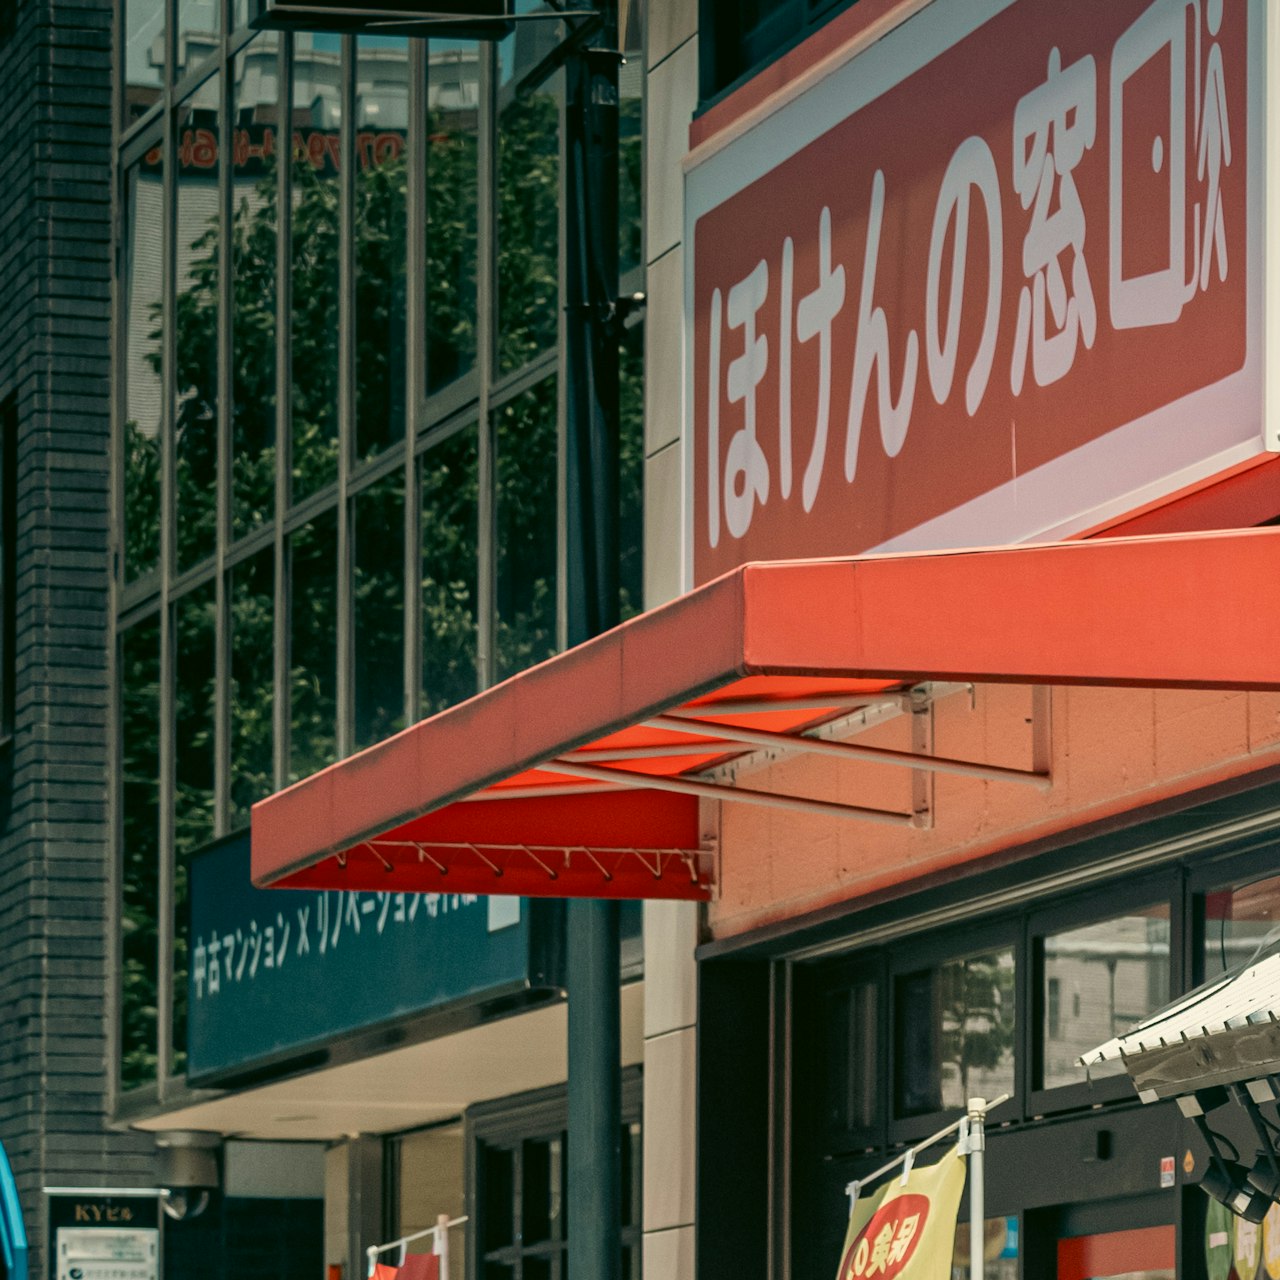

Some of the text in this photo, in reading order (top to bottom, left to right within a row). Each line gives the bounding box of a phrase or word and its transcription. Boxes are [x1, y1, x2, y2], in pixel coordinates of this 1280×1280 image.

[708, 2, 1201, 550] ほけんの窓口
[74, 1204, 134, 1222] KYビル
